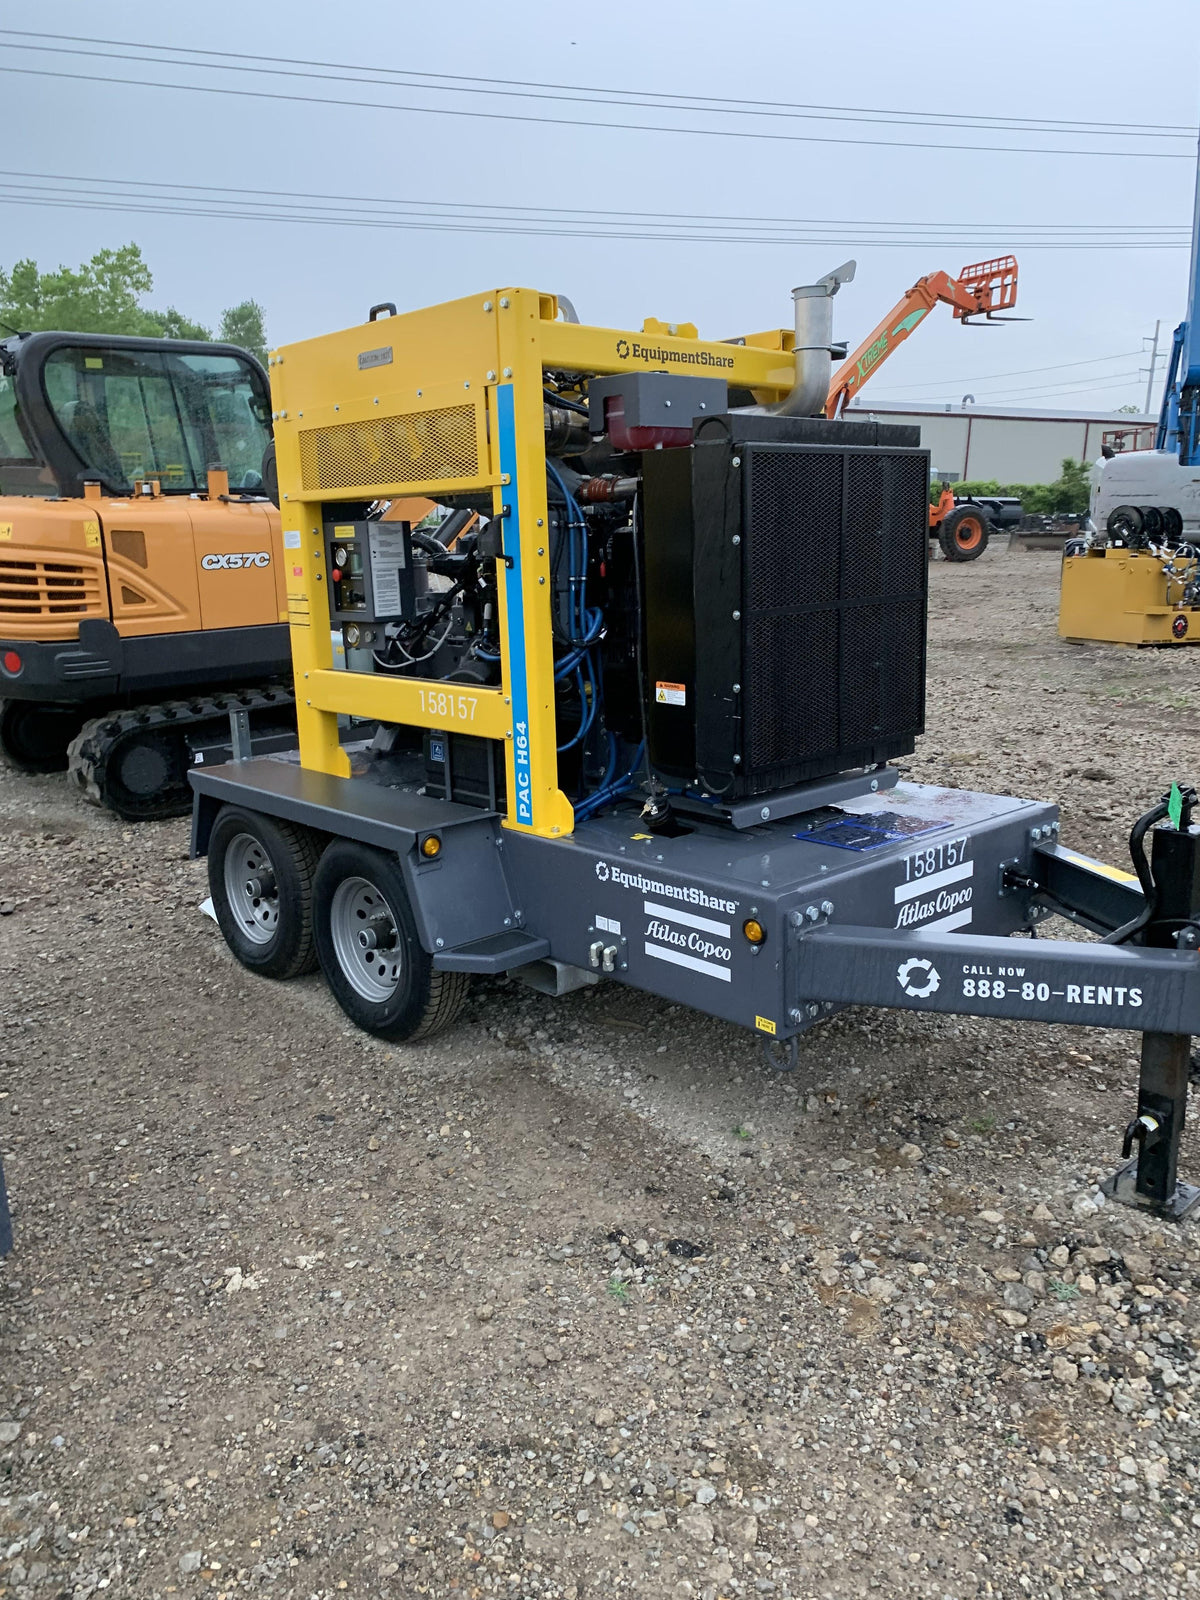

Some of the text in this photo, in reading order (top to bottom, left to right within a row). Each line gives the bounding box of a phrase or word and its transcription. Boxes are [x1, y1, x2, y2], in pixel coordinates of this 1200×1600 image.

[632, 343, 734, 368] EquipmentShare
[857, 330, 889, 386] XTREME
[201, 551, 271, 570] CX57C
[418, 690, 478, 720] 158157
[516, 721, 530, 818] PAC H64
[903, 836, 968, 881] 158157
[962, 965, 1026, 977] CALL NOW
[962, 978, 1143, 1008] 888-80-RENTS
